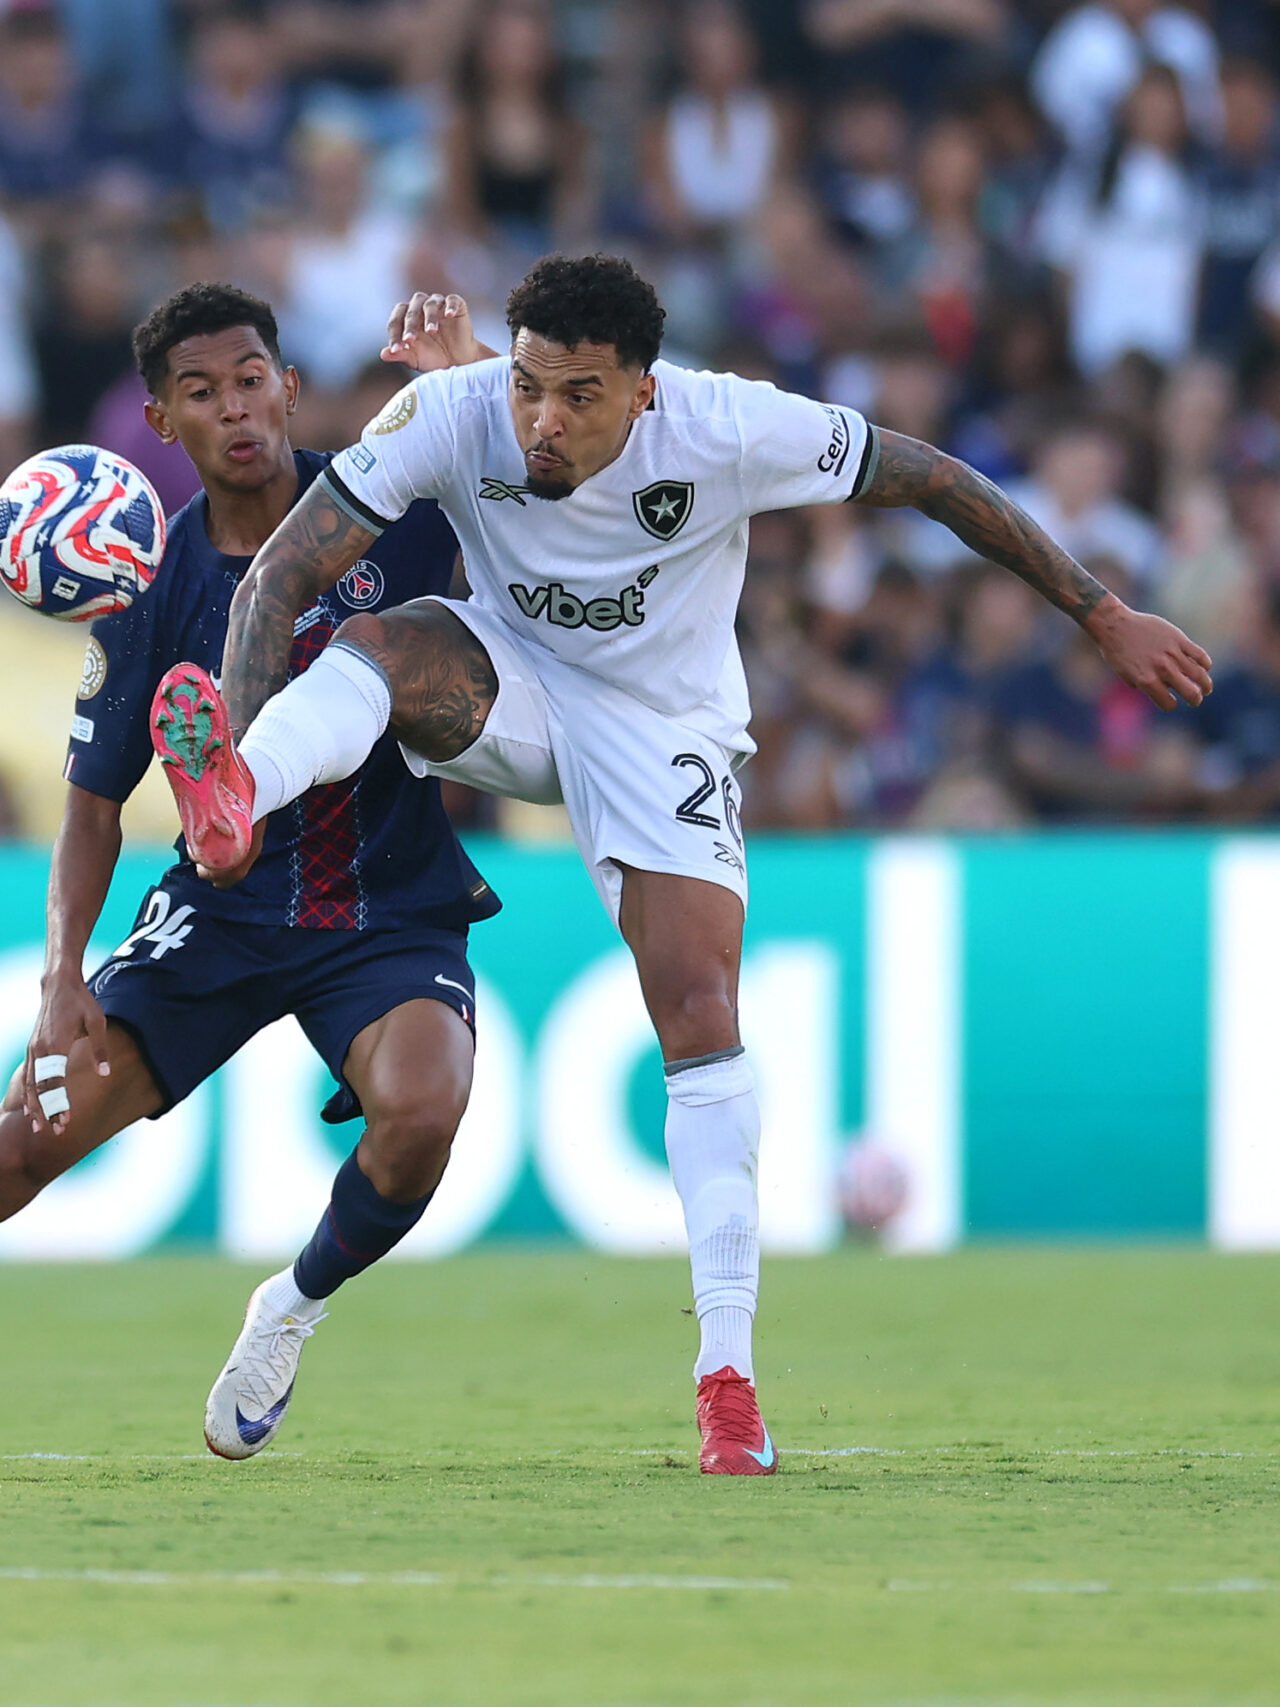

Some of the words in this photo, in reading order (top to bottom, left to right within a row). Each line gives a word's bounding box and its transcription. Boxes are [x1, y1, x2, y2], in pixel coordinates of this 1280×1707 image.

[508, 583, 645, 631] vbet
[671, 753, 742, 852] 26
[112, 890, 198, 960] 24
